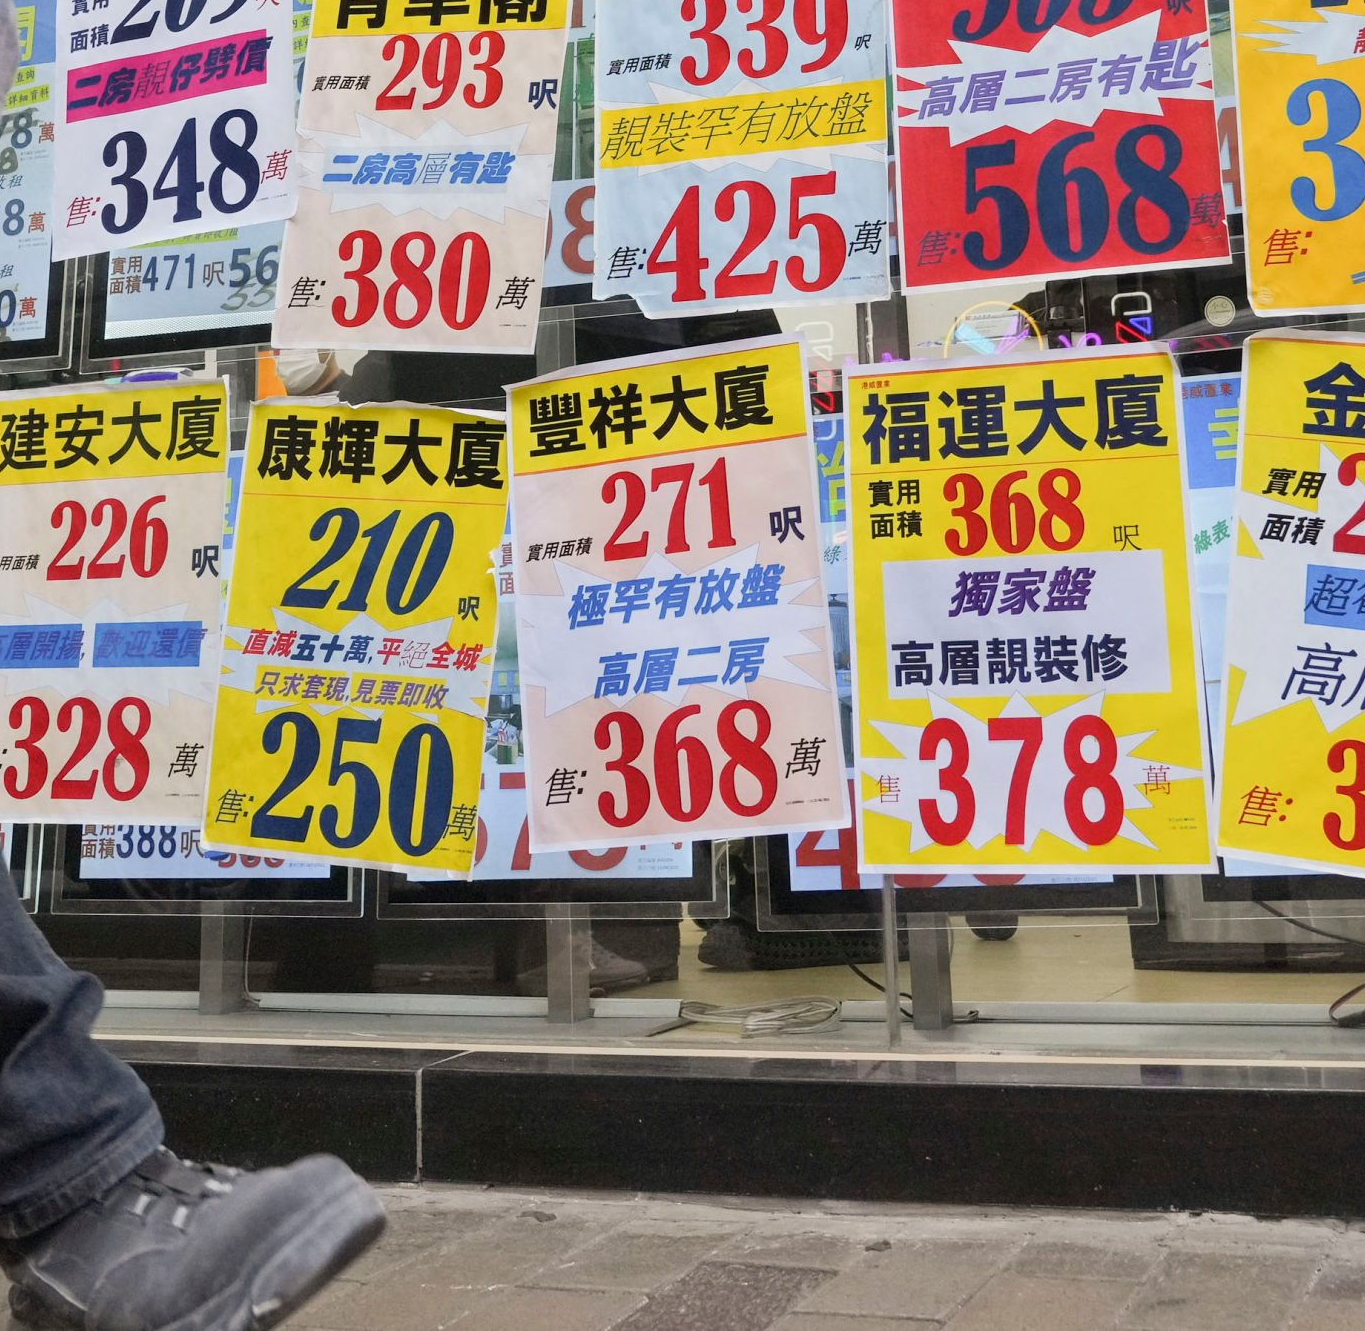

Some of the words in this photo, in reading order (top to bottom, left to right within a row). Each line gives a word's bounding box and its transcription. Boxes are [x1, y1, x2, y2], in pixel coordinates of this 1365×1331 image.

[376, 30, 506, 112] 293
[916, 41, 1201, 121] 高層二房有匙
[101, 107, 262, 236] 348
[322, 149, 517, 187] 二房高層有匙
[600, 90, 873, 163] 靚裝罕有放盤
[645, 171, 847, 304] 425
[960, 123, 1192, 272] 568
[331, 228, 492, 331] 380
[256, 415, 506, 490] 康輝大廈
[529, 365, 775, 458] 豐祥大廈
[861, 373, 1169, 464] 福運大廈
[45, 494, 169, 582] 226
[600, 457, 737, 562] 271
[942, 467, 1086, 556] 368
[281, 507, 455, 615] 210
[567, 563, 785, 631] 極罕有放盤
[948, 566, 1097, 618] 獨家盤
[890, 632, 1130, 688] 高層靚裝修
[3, 696, 152, 803] 328
[250, 710, 454, 858] 250
[593, 699, 779, 829] 368
[917, 713, 1125, 846] 378
